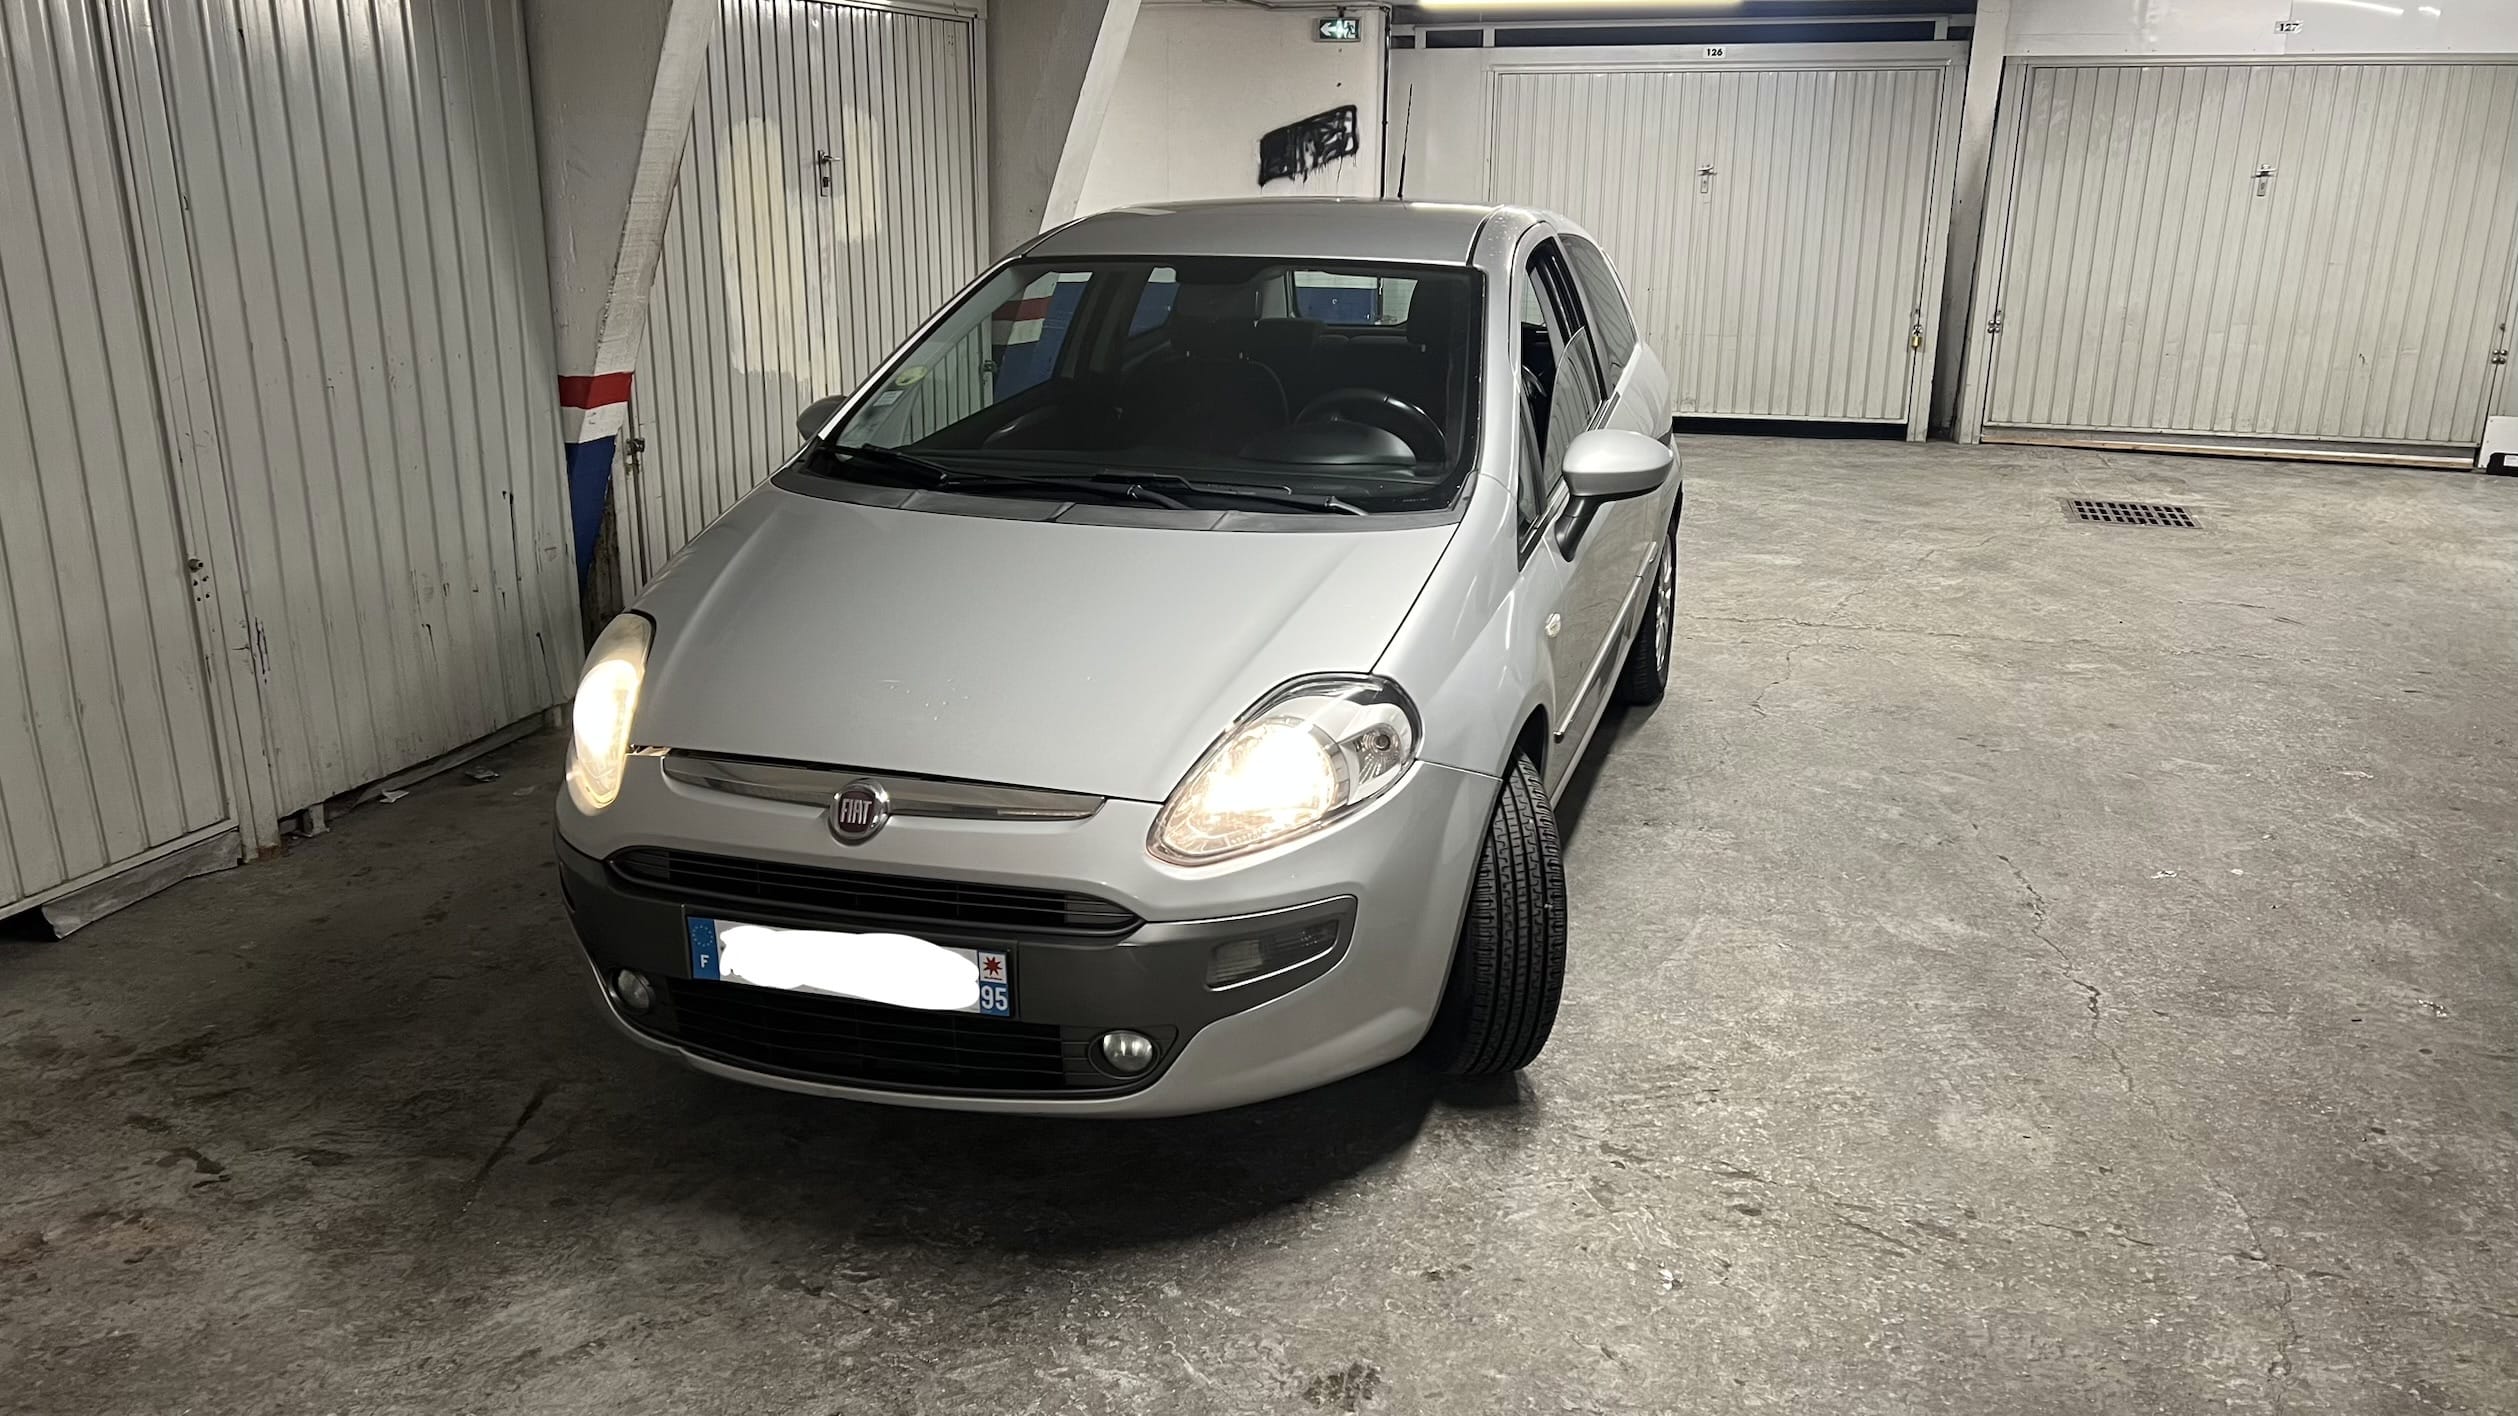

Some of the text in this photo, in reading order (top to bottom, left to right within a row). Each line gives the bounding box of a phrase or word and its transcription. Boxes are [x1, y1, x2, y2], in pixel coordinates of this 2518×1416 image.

[2280, 23, 2299, 31] 127
[1707, 48, 1723, 56] 126
[840, 798, 873, 825] FIAT
[700, 954, 709, 968] F
[981, 985, 1008, 1011] 95
